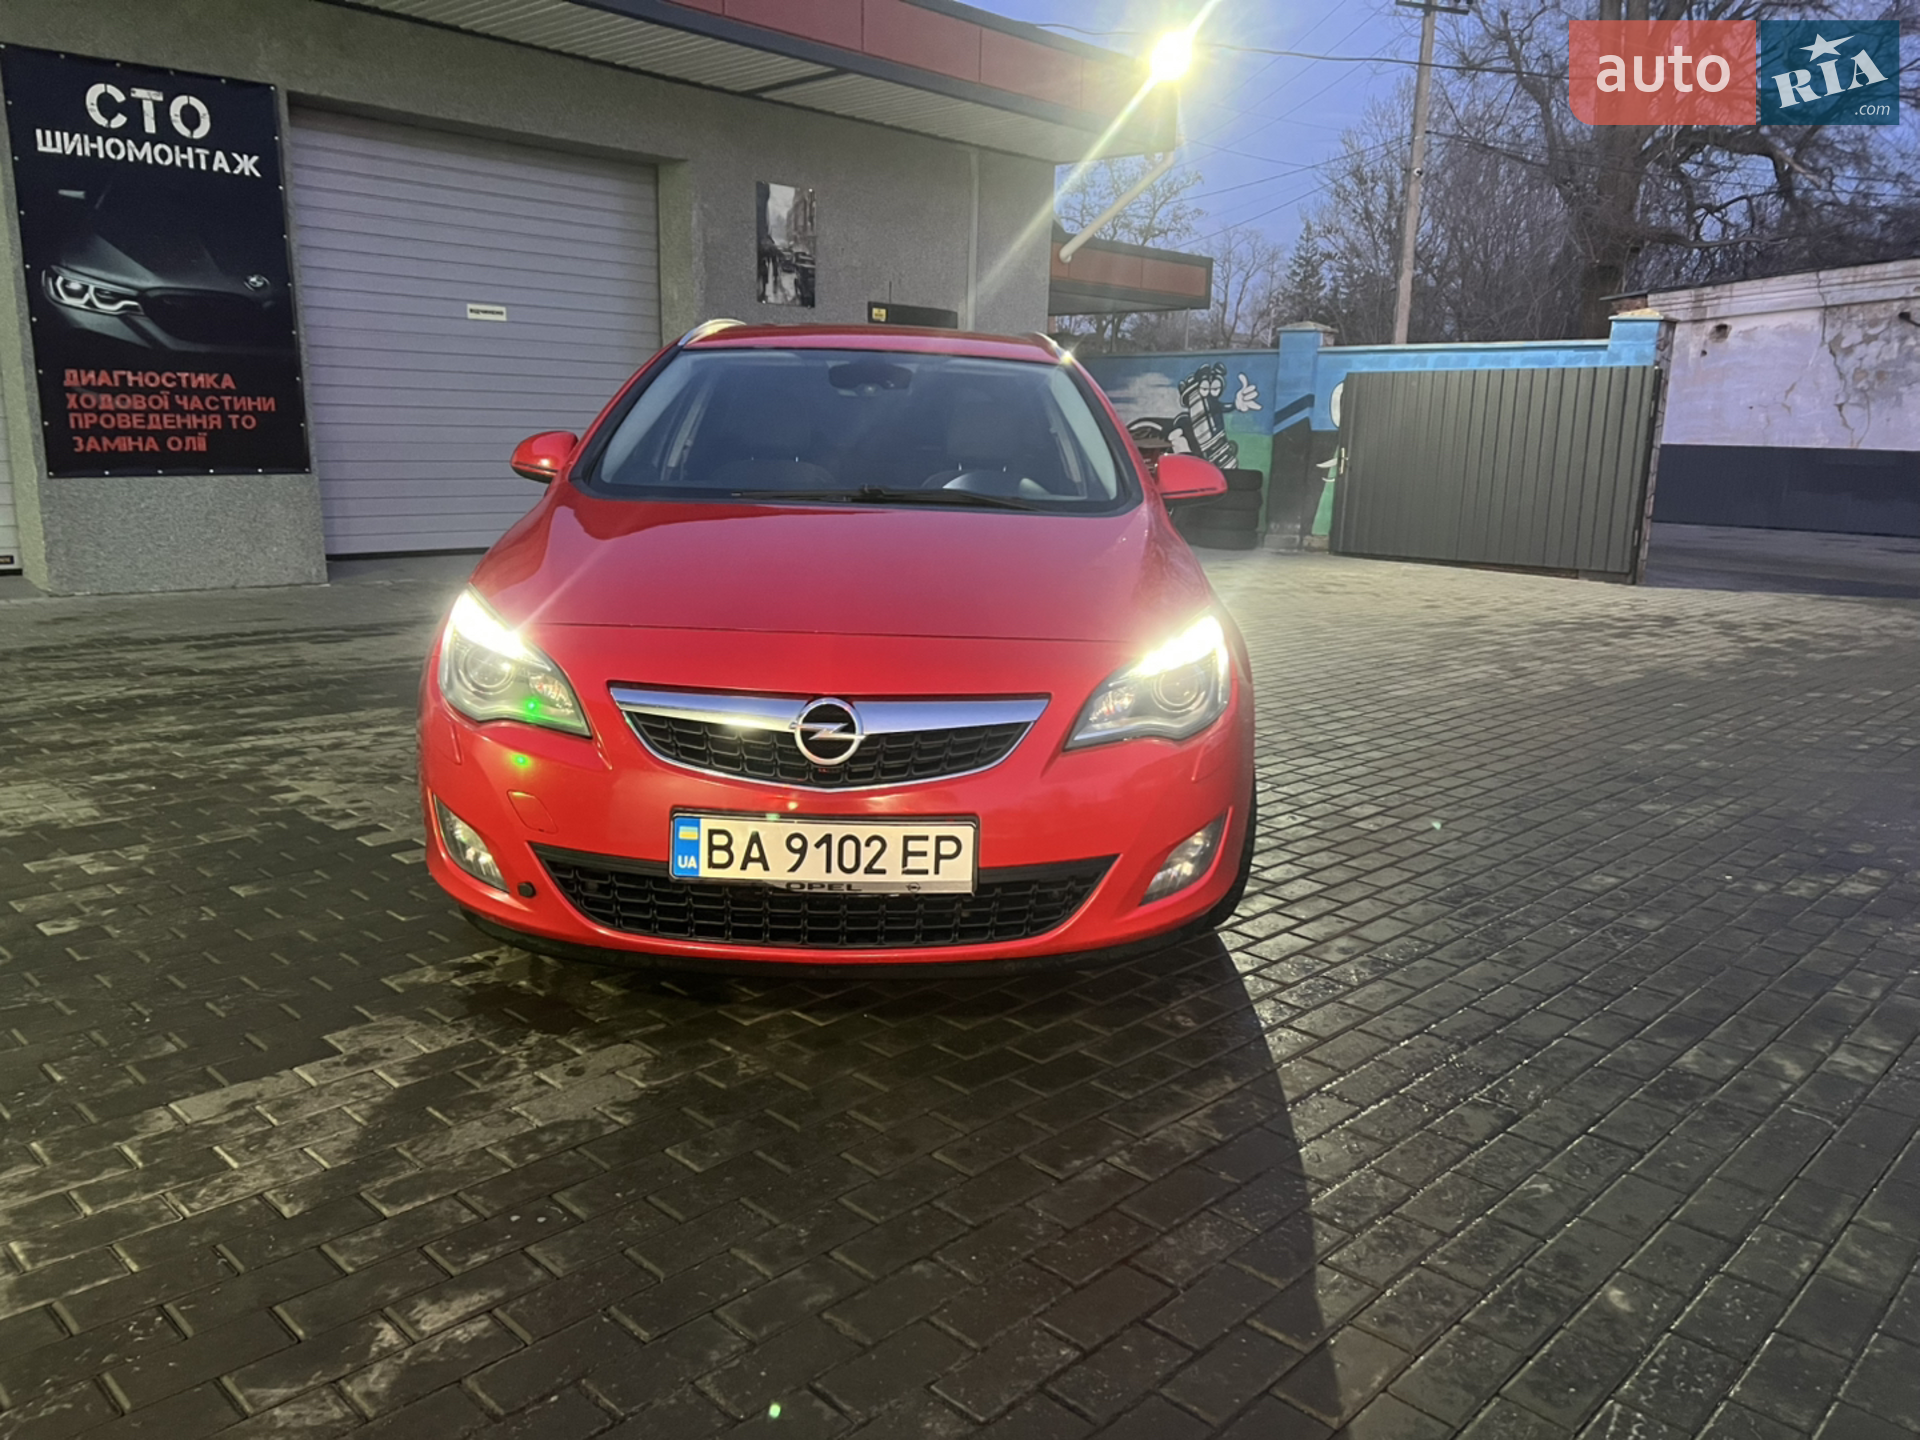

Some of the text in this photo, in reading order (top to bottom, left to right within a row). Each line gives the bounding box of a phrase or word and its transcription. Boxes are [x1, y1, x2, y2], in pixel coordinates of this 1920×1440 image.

[85, 83, 211, 139] СТО
[35, 128, 262, 178] ШИНОМОНТАЖ
[63, 369, 236, 389] ДИАГНОСТИКА
[66, 391, 276, 412] ХОДОВОЇ ЧАСТИНИ
[69, 413, 257, 430] ПРОВЕДЕННЯ ТО
[72, 436, 160, 452] ЗАМІНА
[677, 855, 697, 869] UA
[707, 828, 962, 876] BA 9102 EP
[785, 881, 862, 892] OPEL
